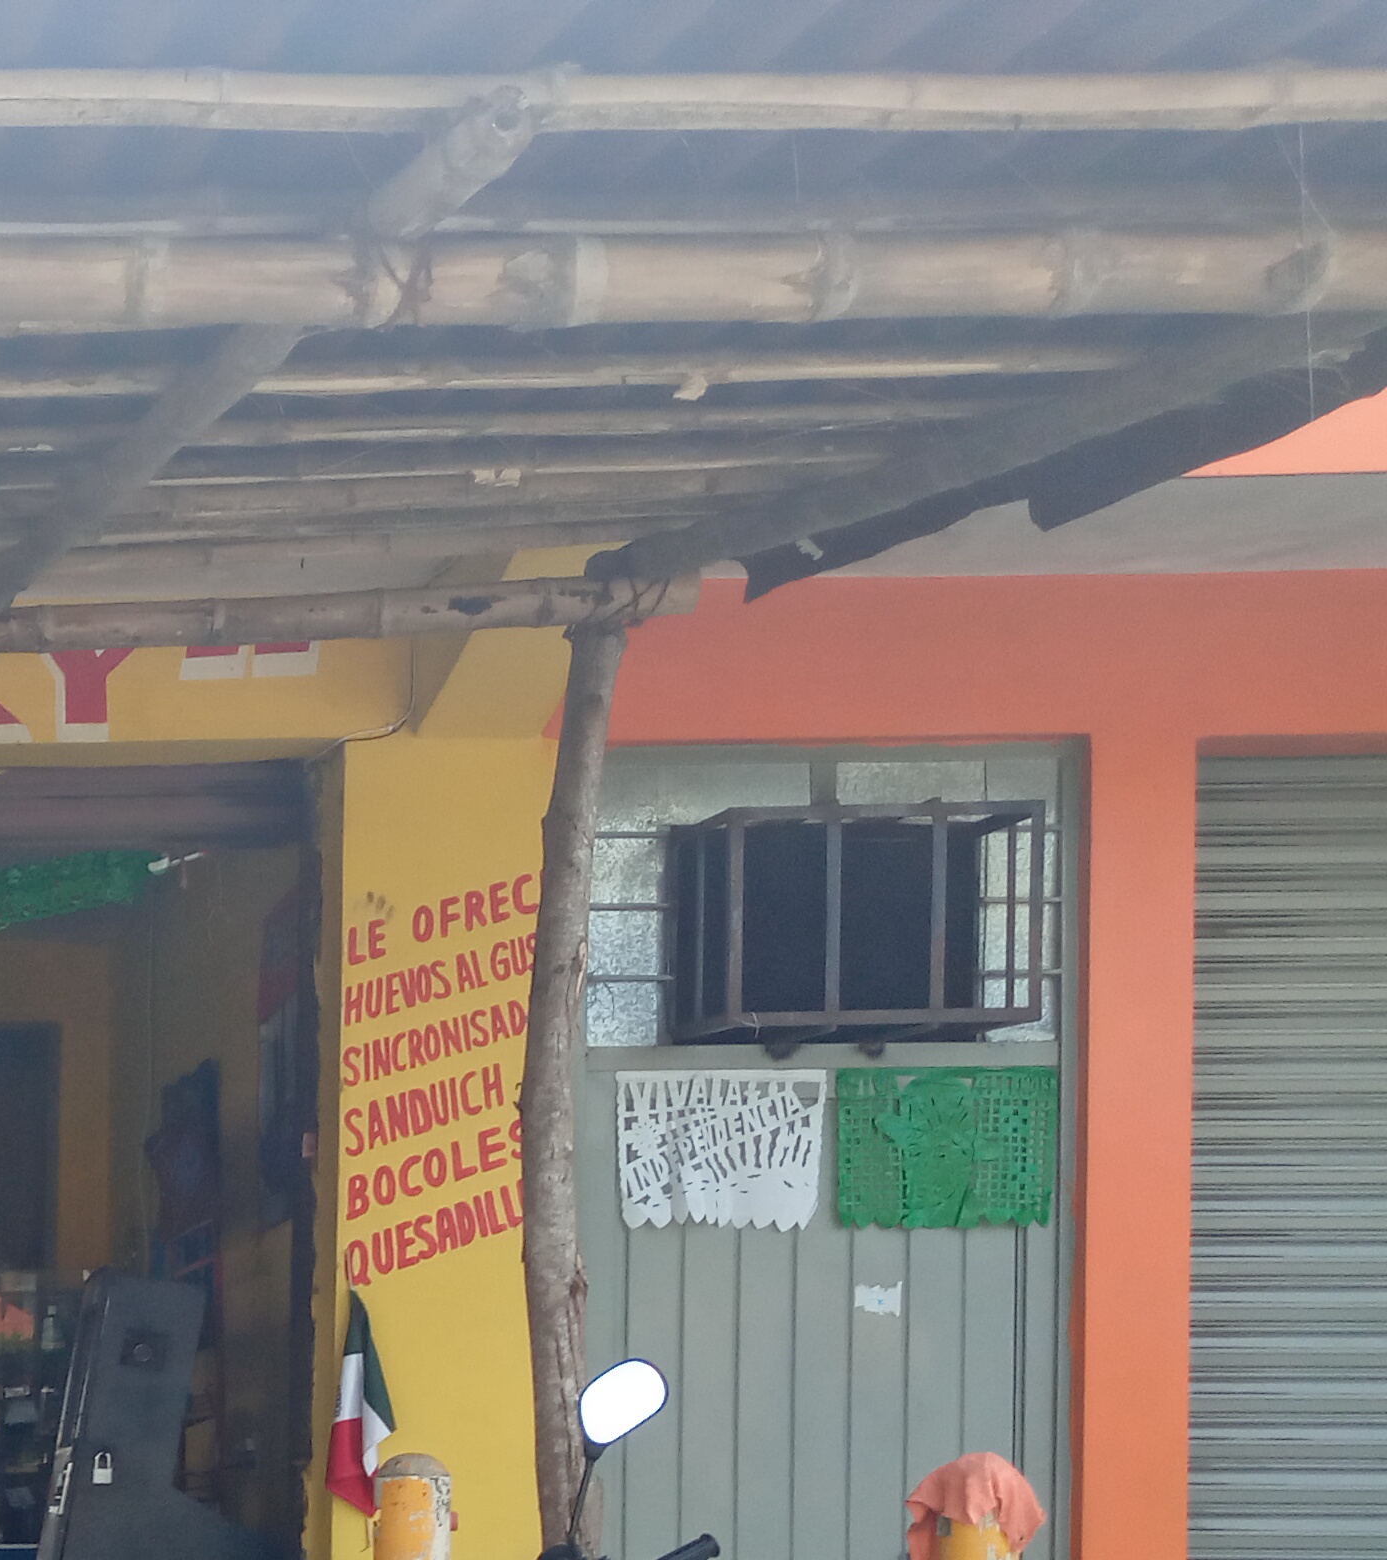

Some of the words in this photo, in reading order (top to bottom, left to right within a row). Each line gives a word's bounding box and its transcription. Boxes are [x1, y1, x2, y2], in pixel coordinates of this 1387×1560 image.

[347, 918, 387, 966] LE
[412, 870, 544, 943] OFREC
[344, 958, 453, 1027] HUEVOS
[456, 948, 489, 994] AL
[344, 1063, 505, 1157] SANDUICH
[345, 1178, 524, 1287] QUESADILL
